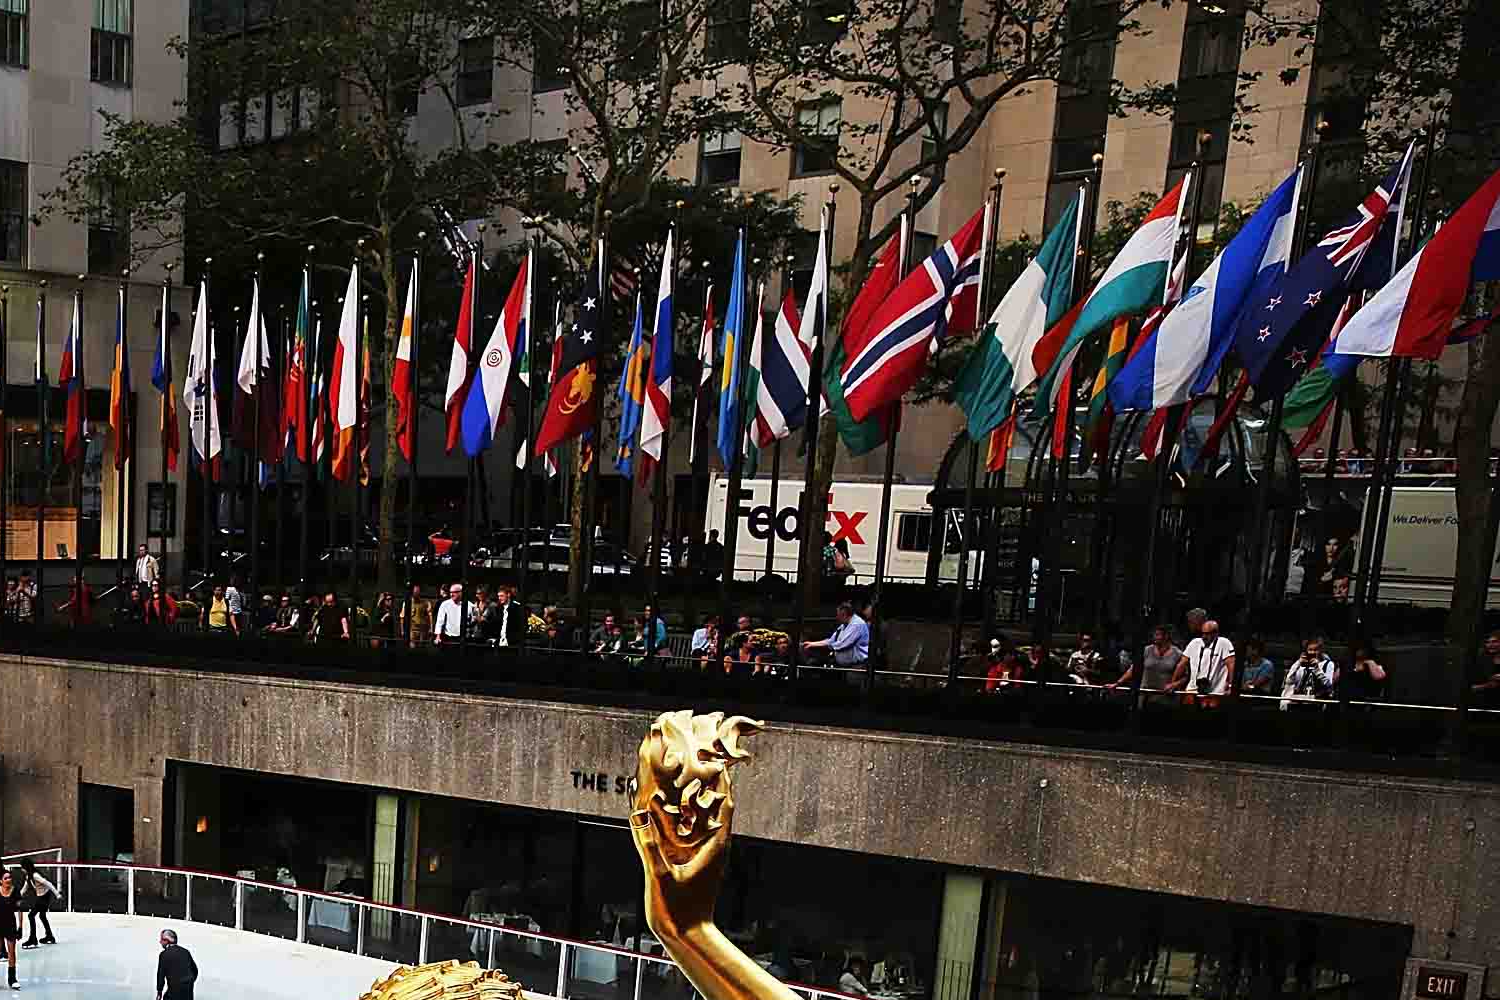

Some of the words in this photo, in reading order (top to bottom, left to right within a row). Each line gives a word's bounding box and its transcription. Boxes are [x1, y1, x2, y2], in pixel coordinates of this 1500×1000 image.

[731, 486, 868, 545] Fedx
[1444, 515, 1459, 526] Fo
[570, 770, 608, 793] THE
[1427, 976, 1456, 996] EXIT
